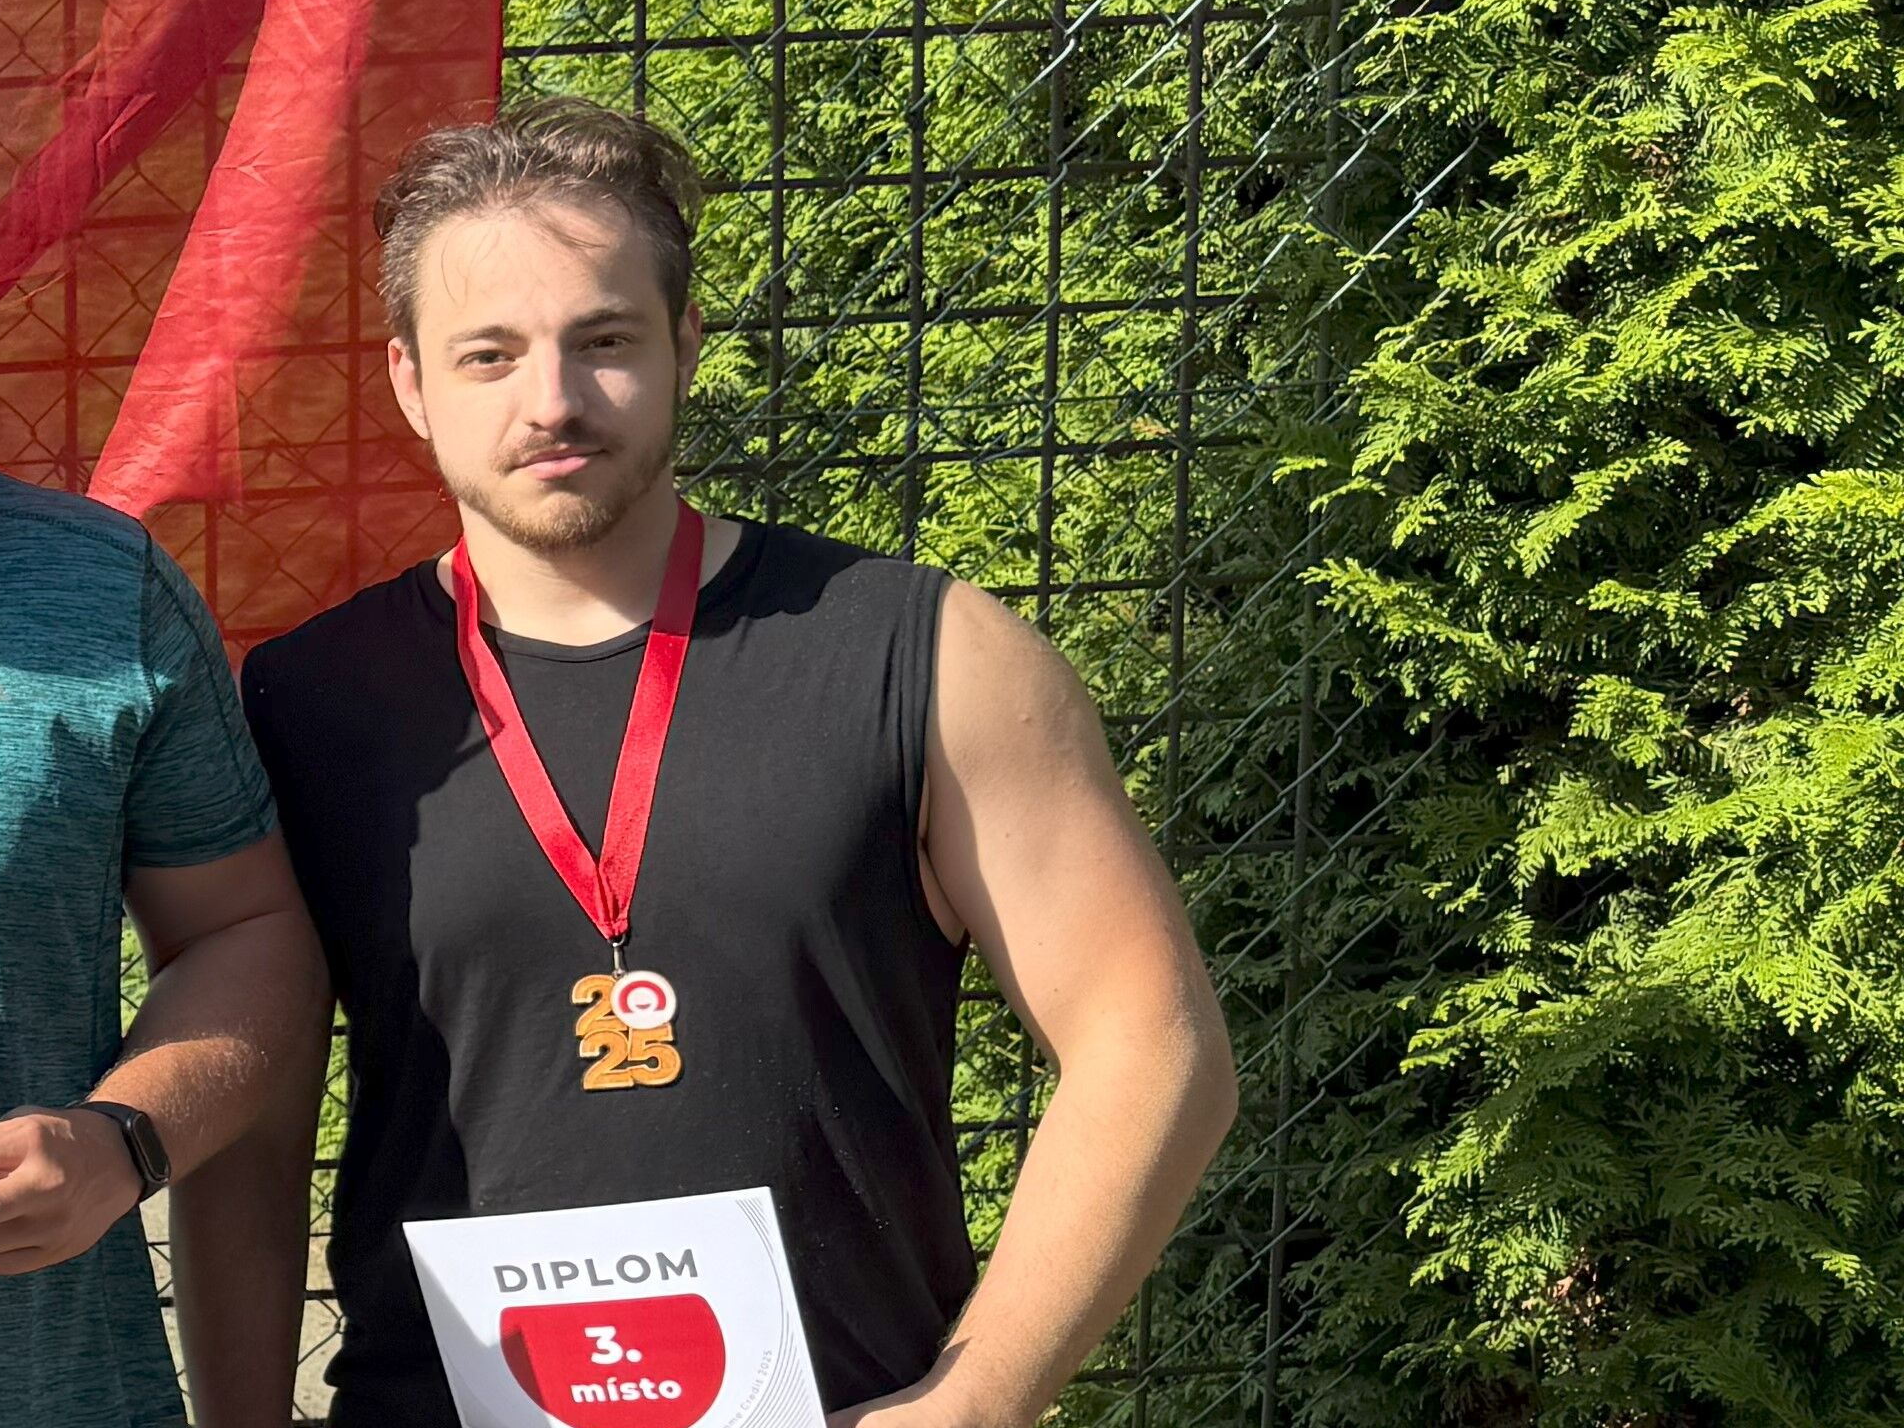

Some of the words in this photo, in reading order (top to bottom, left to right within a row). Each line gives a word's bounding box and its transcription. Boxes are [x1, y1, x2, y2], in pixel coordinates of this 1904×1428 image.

[493, 1249, 699, 1293] DIPLOM
[584, 1326, 643, 1365] 3.
[570, 1377, 682, 1403] místo
